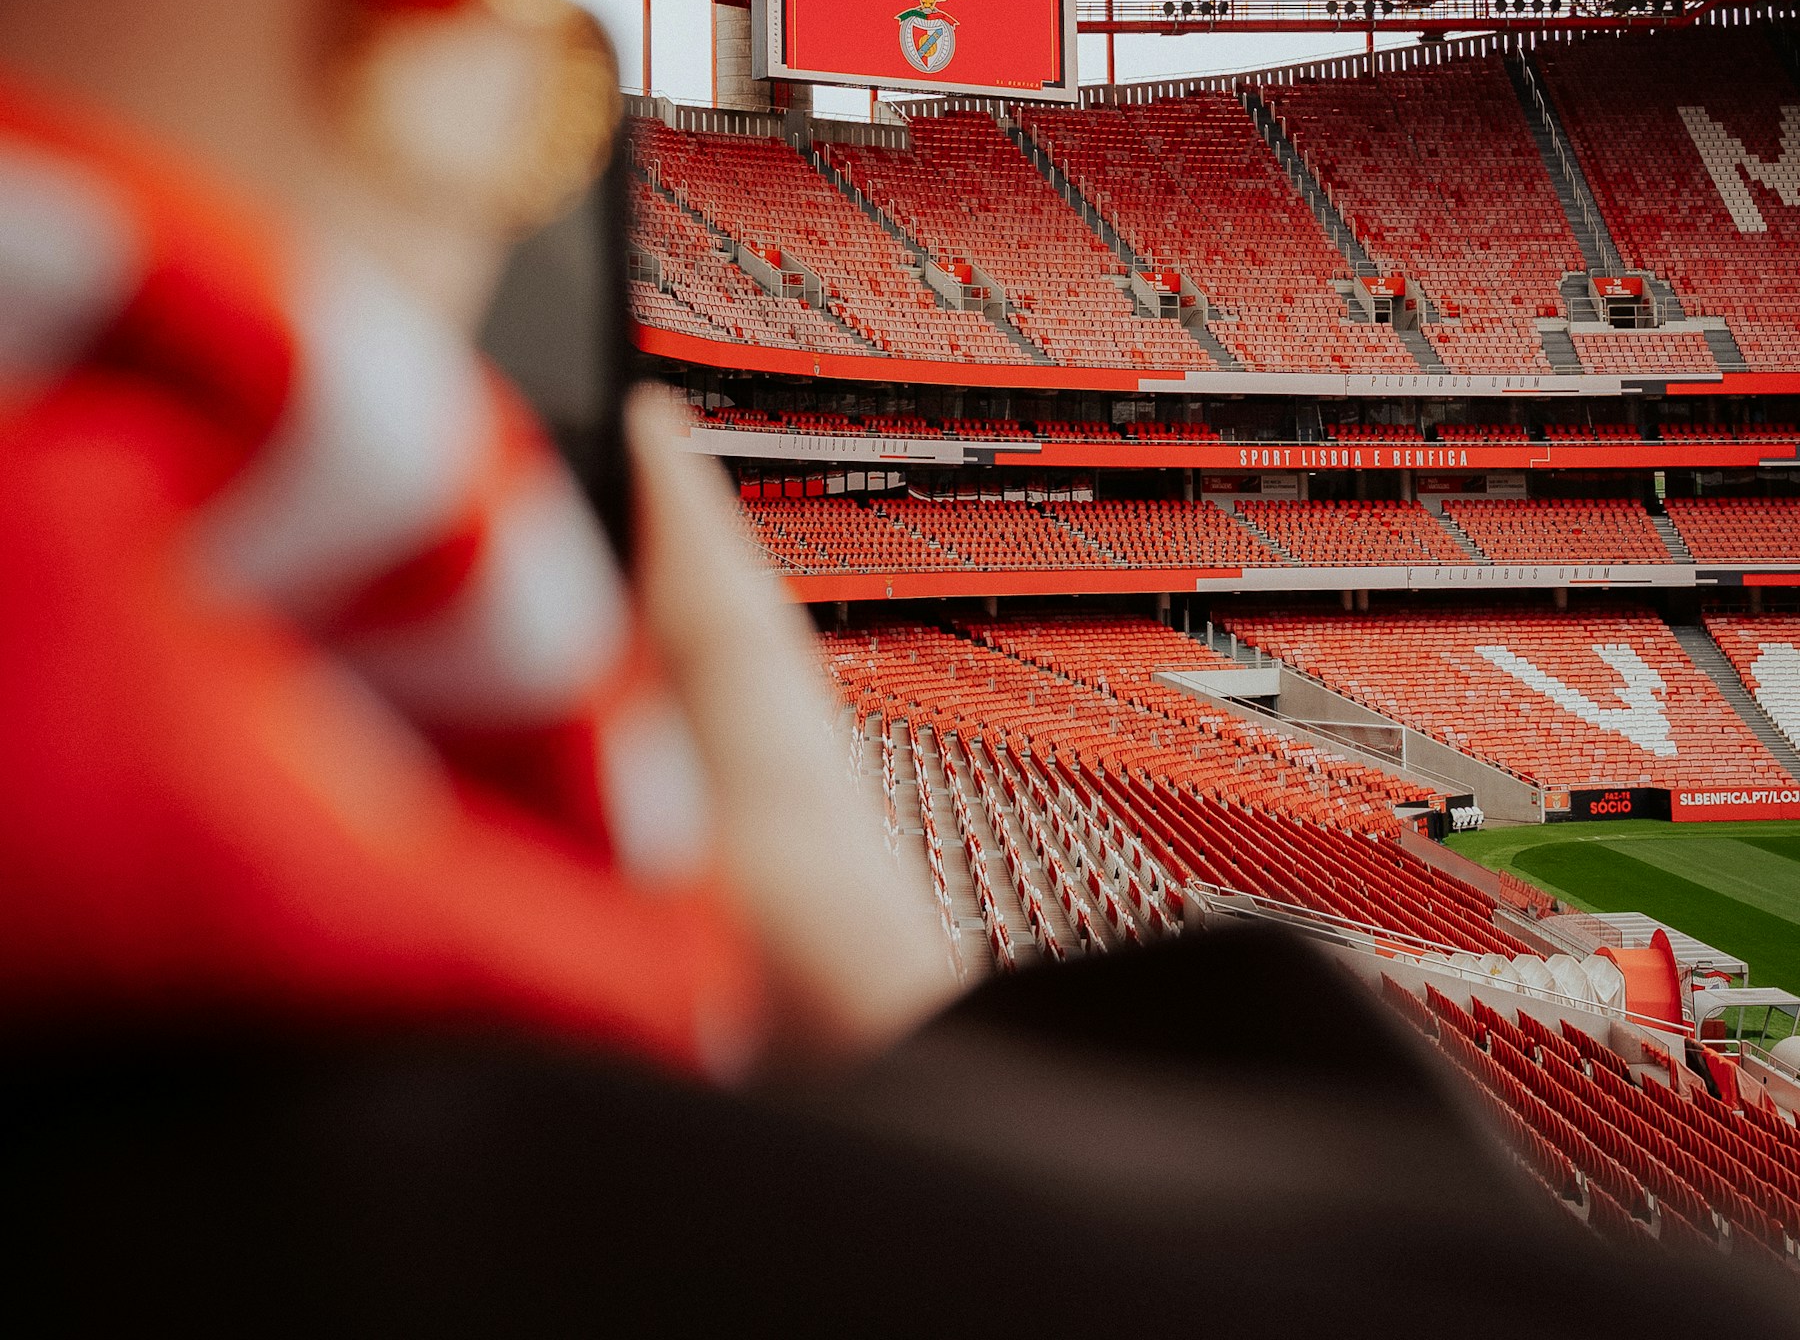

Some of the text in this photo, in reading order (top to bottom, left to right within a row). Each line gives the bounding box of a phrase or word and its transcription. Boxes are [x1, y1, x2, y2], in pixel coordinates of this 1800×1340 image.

[1371, 376, 1472, 388] PLURIBUS
[1491, 376, 1541, 388] UNUM
[792, 436, 857, 452] PLURIBUS
[871, 439, 909, 453] UNUM
[1239, 449, 1468, 467] SPORT LISBOA E BENFICA
[1434, 568, 1539, 580] PLURIBUS
[1559, 567, 1611, 580] UNUM
[1604, 791, 1631, 800] FAZ-TE
[1679, 790, 1800, 806] SLBENFICA.PT/LOJ
[1590, 798, 1632, 815] SÓCIO
